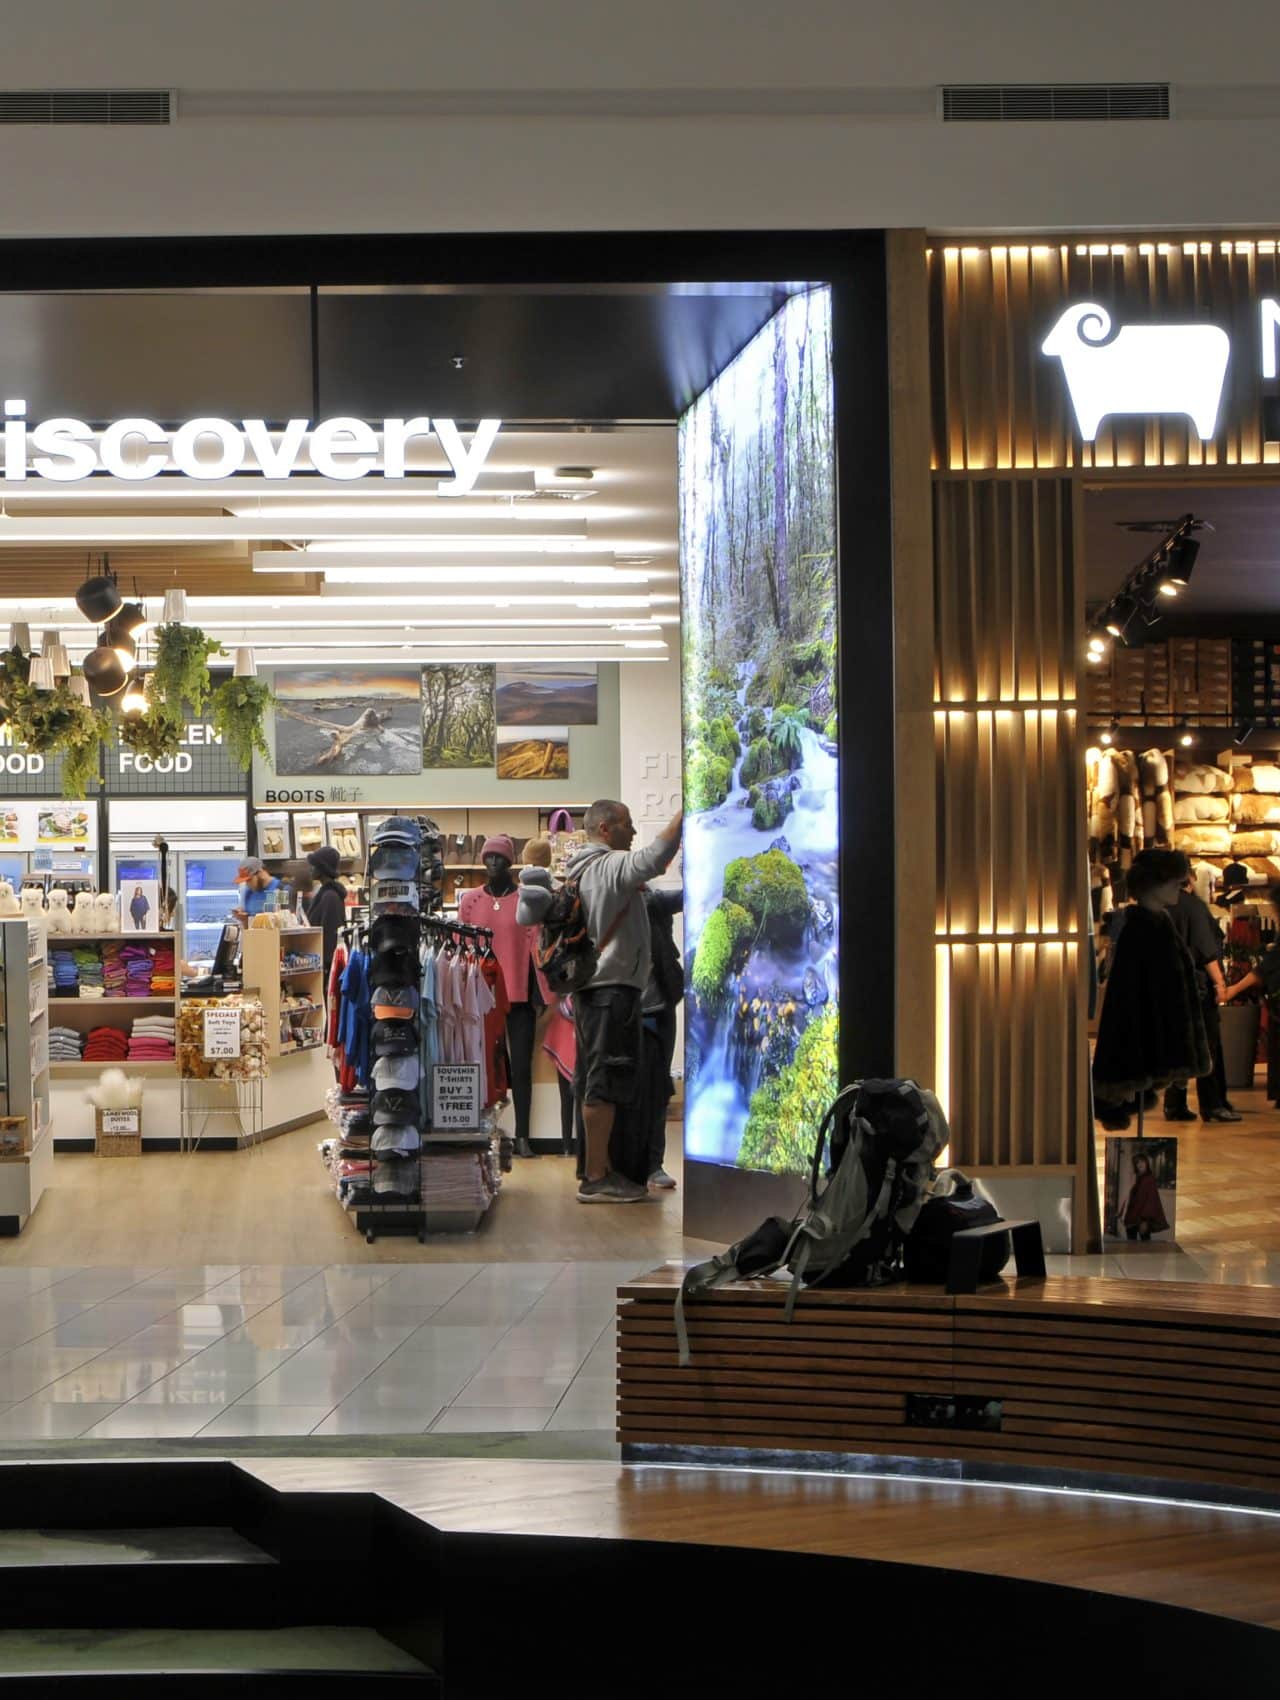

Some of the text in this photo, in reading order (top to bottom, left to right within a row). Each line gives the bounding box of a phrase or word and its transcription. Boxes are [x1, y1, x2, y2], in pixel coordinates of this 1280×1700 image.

[119, 752, 193, 773] FOOD
[265, 789, 325, 803] BOOTS
[210, 1047, 234, 1055] $7.00
[439, 1086, 462, 1094] BUY
[446, 1102, 473, 1110] FREE
